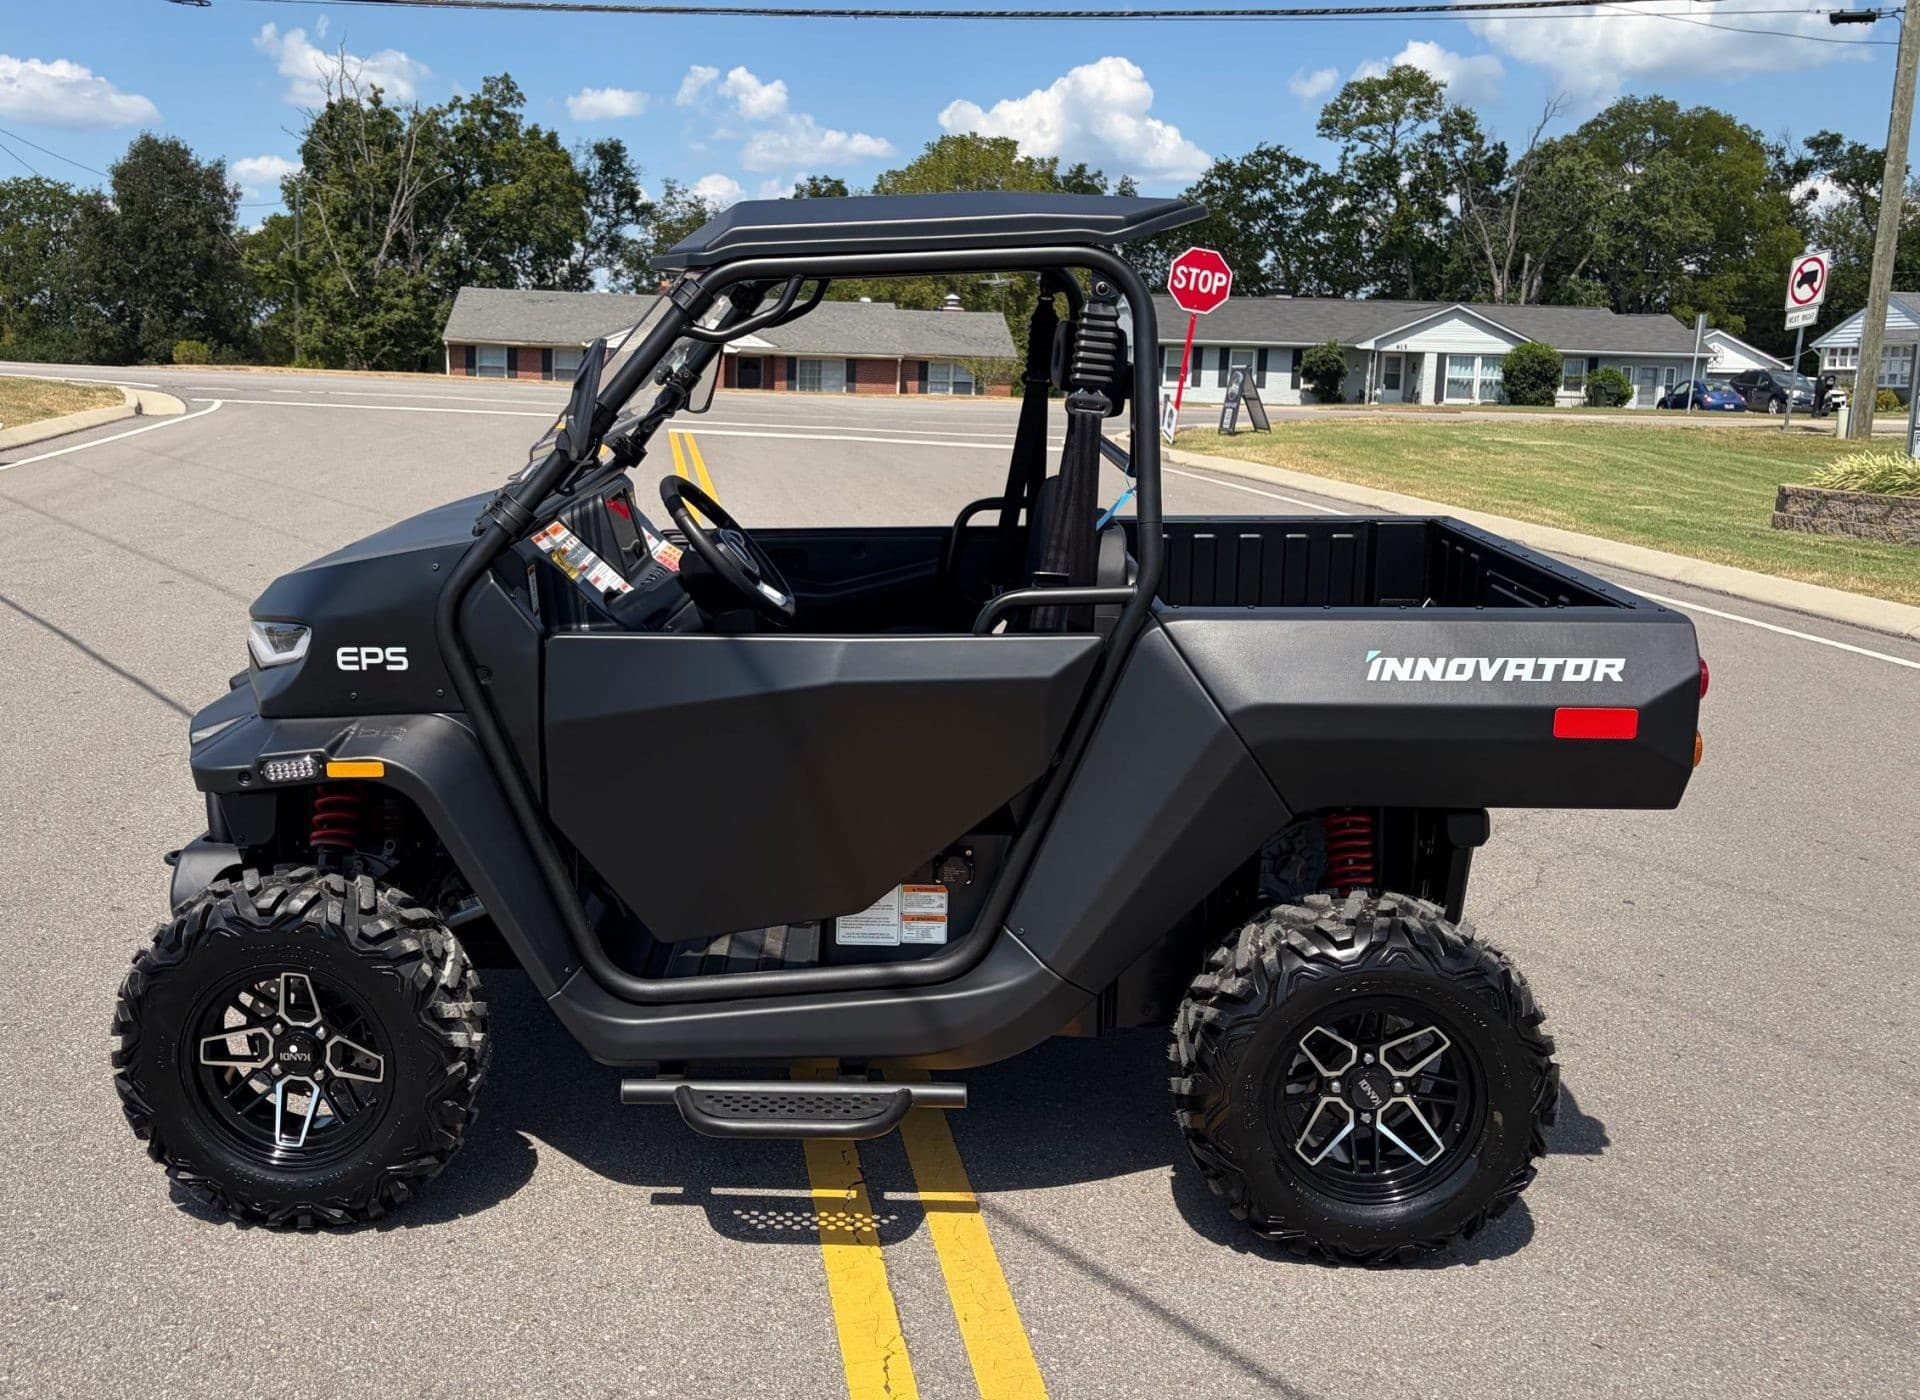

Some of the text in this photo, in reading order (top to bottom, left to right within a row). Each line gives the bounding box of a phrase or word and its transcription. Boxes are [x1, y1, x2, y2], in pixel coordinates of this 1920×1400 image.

[1173, 265, 1227, 295] STOP
[336, 646, 409, 671] EPS
[1366, 651, 1626, 682] INNOVATOR
[279, 1052, 311, 1062] KANDI
[1359, 1079, 1382, 1106] KANDI
